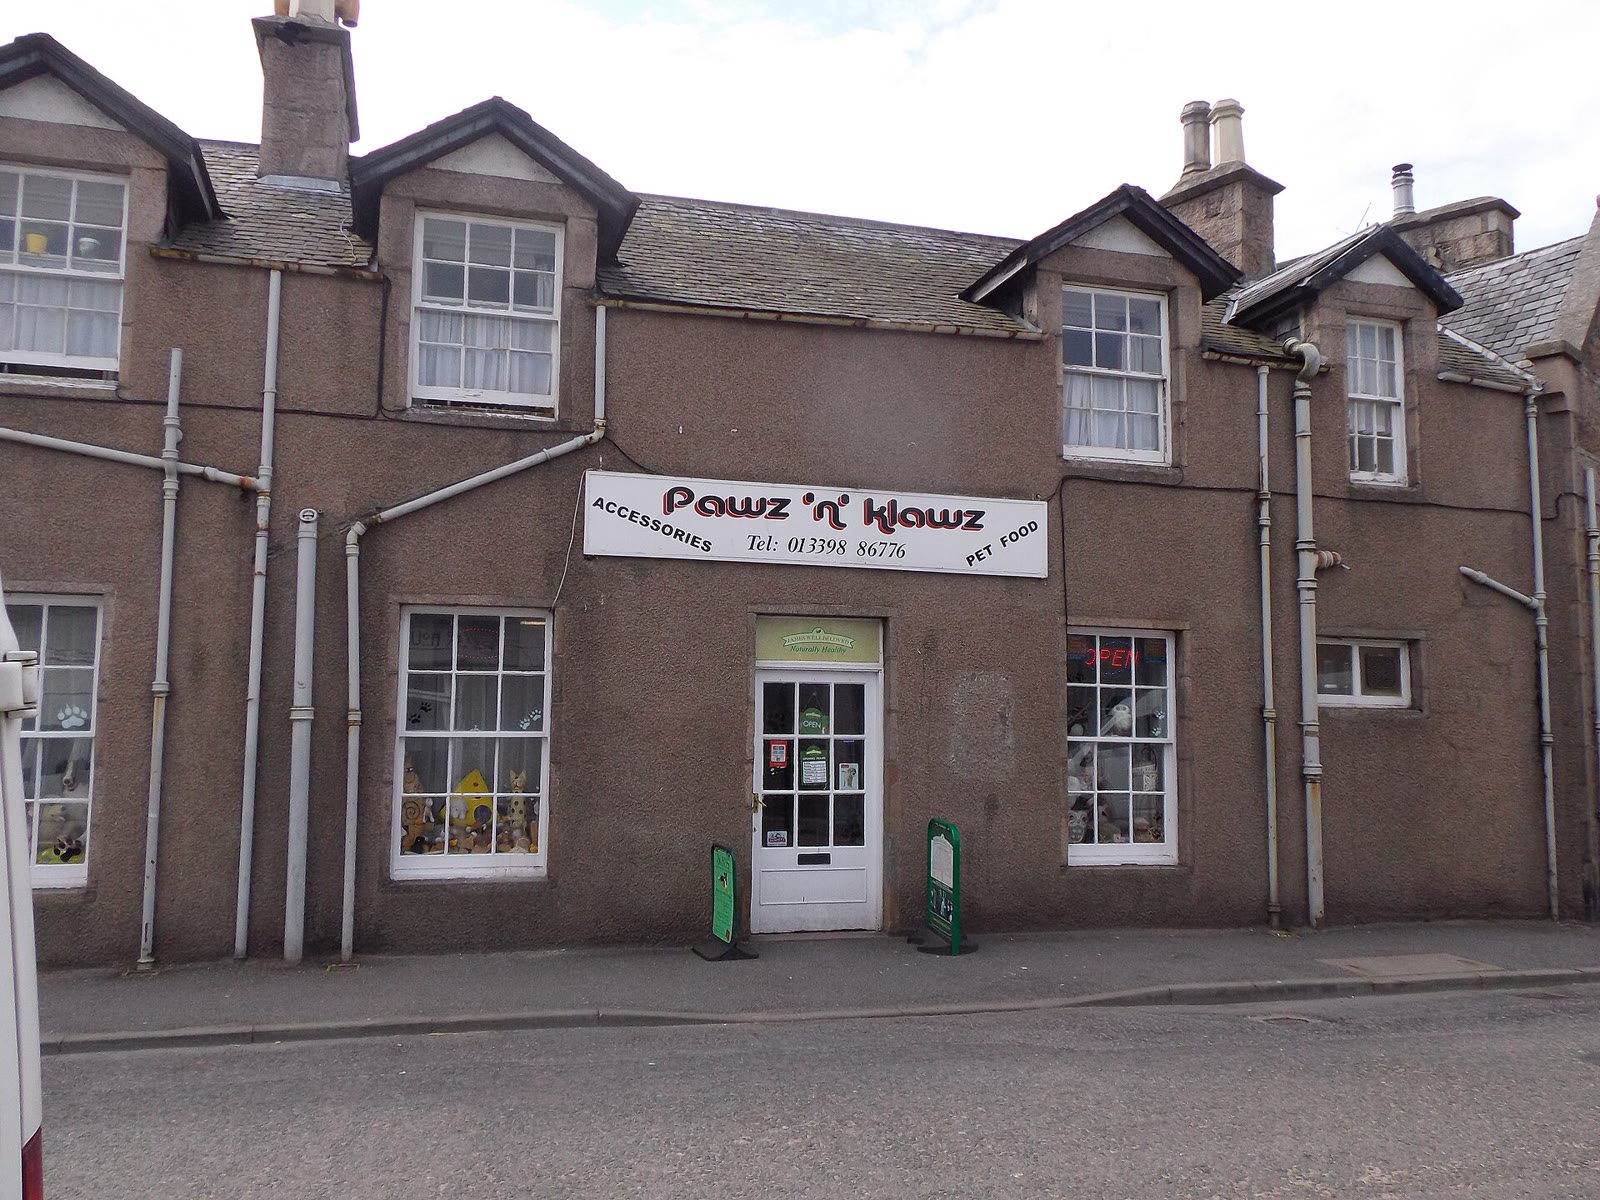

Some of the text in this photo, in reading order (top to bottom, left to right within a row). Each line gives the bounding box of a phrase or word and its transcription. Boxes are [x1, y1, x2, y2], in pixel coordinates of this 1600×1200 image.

[591, 497, 713, 553] ACCESSORIES
[662, 486, 792, 520] Pawz
[802, 492, 850, 531] 'n'
[747, 534, 907, 559] Tel: 013398 86776
[965, 520, 1039, 567] PET FOOD
[790, 645, 820, 654] Naturally
[803, 720, 821, 728] OPEN
